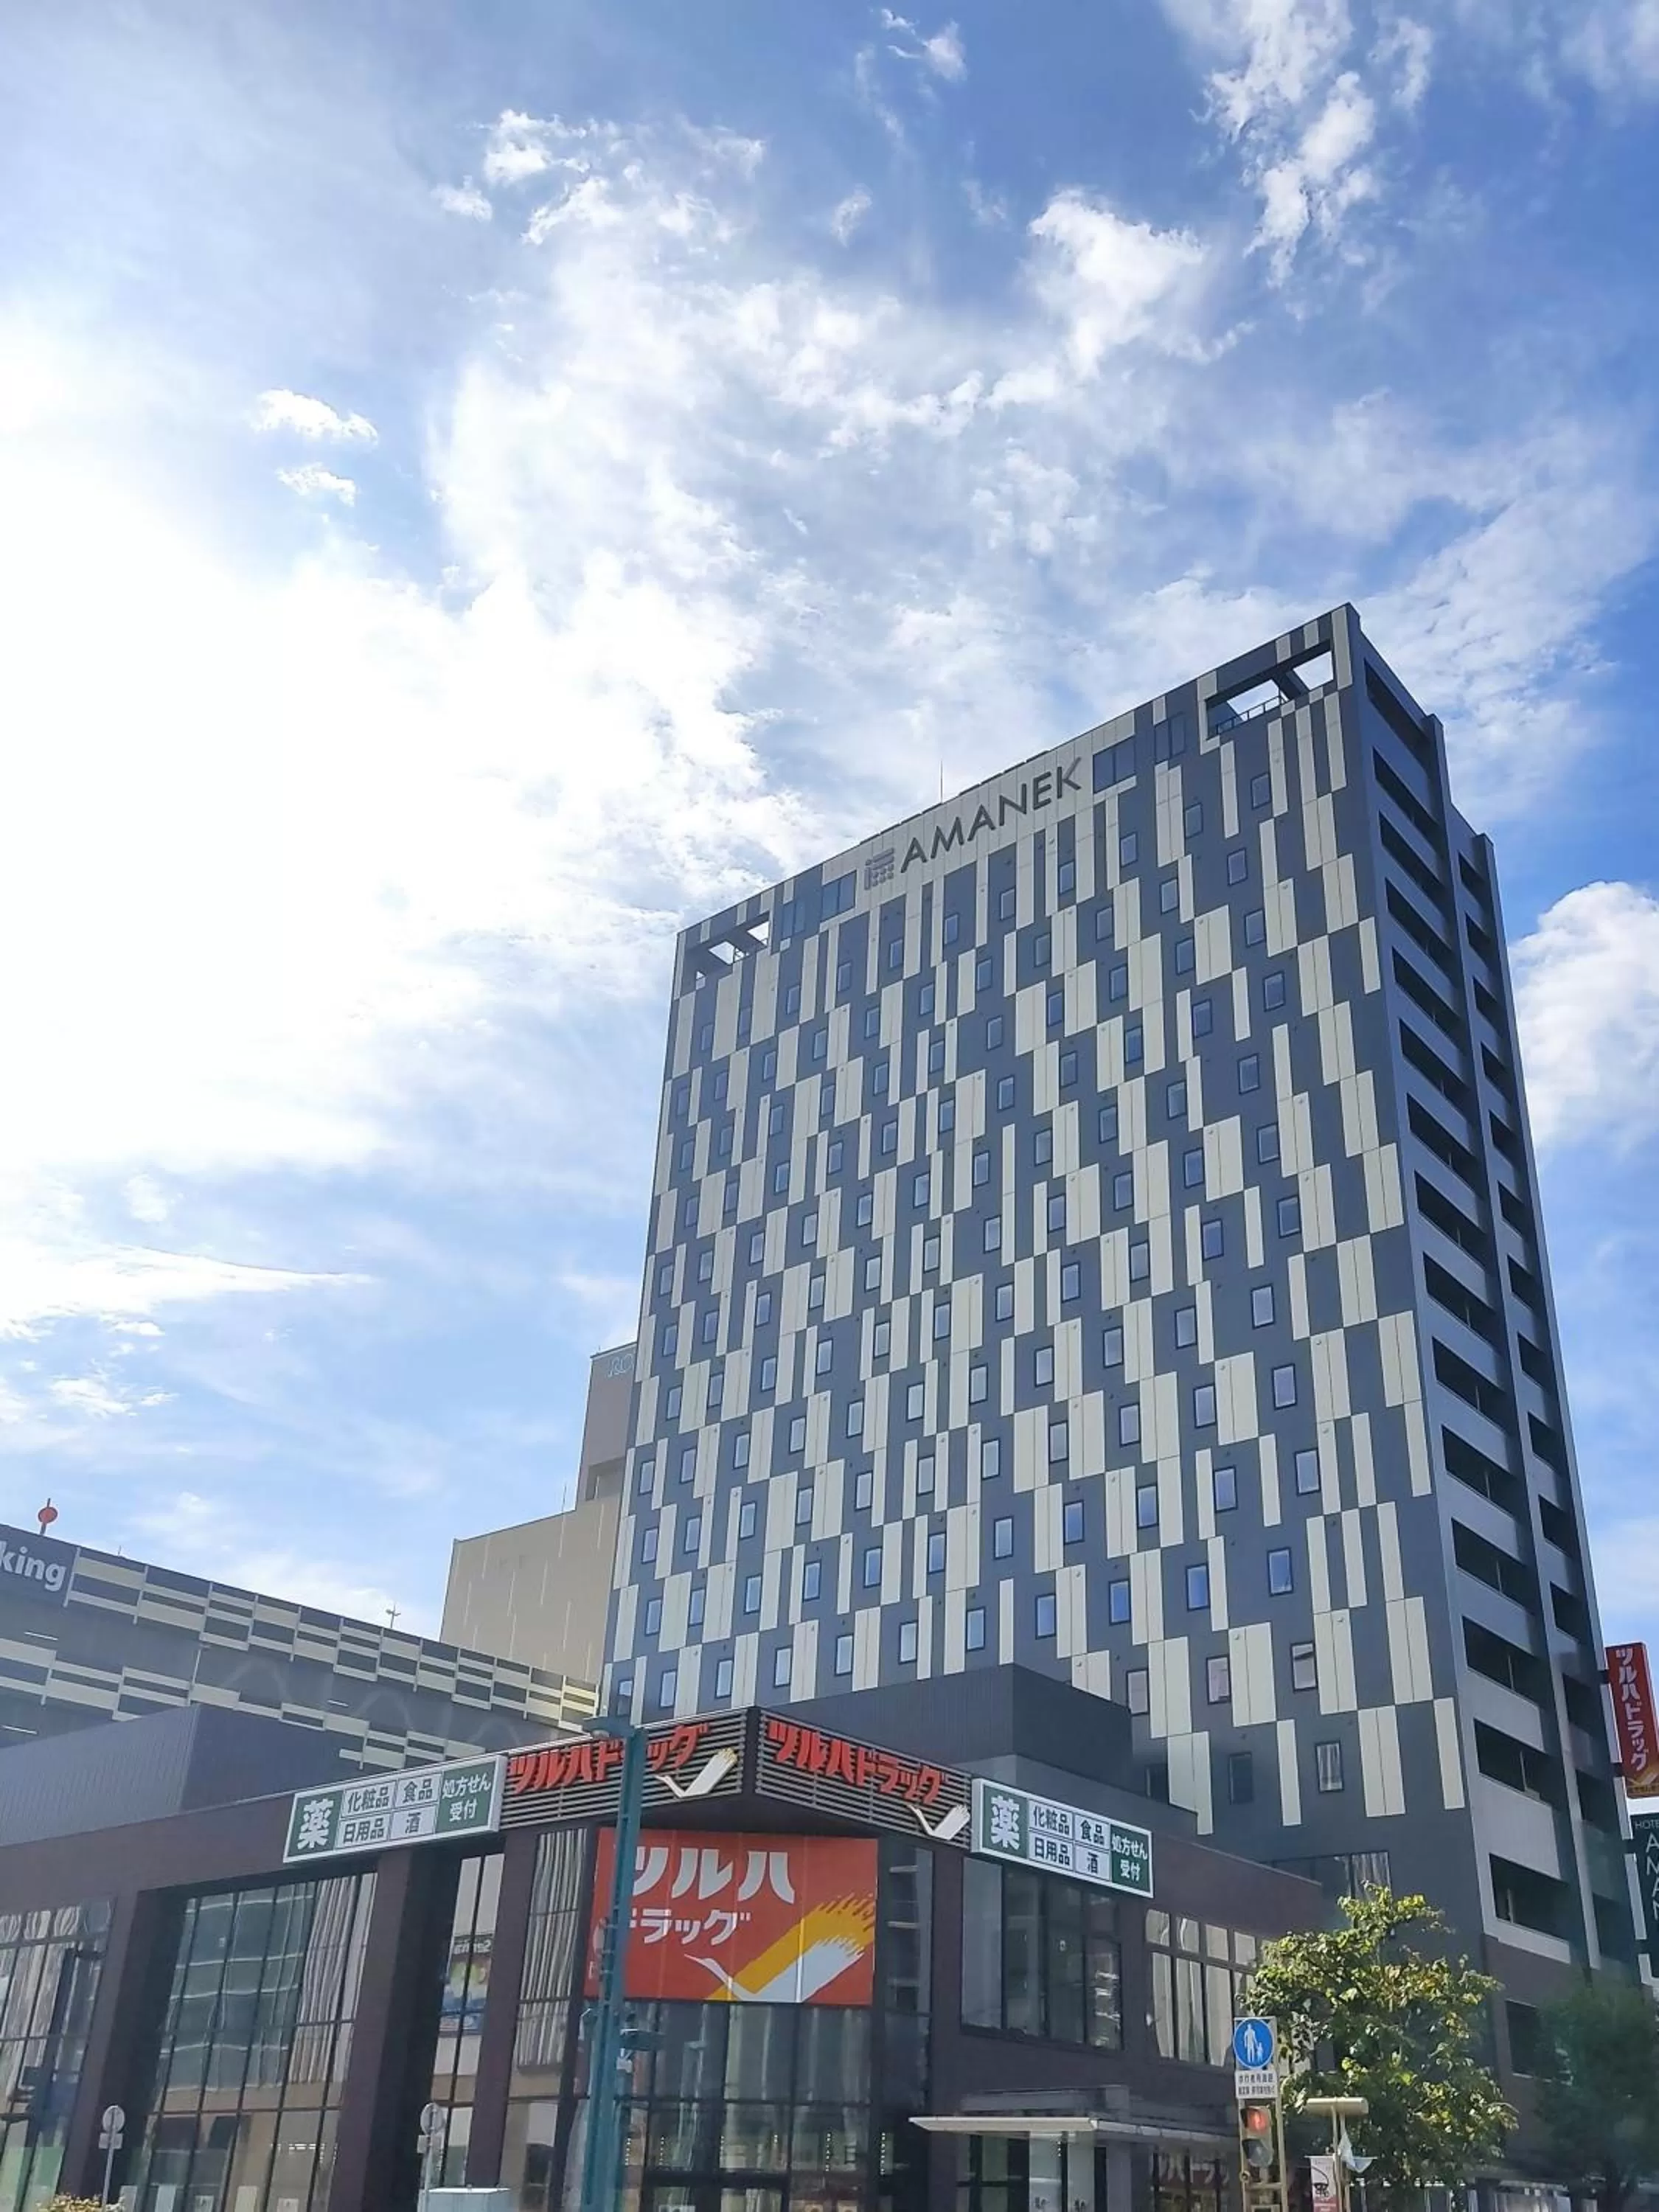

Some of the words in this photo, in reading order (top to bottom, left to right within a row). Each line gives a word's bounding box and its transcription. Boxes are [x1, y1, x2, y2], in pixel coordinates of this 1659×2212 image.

[900, 757, 1082, 874] AMANEK
[0, 1540, 66, 1592] king
[1615, 1646, 1649, 1771] ツルハドラッグ
[509, 1723, 711, 1795] ツルハドッグ
[768, 1719, 950, 1804] ツルハドラッグ
[347, 1786, 390, 1813] 化粧品
[403, 1778, 433, 1804] 食品
[442, 1771, 492, 1801] 処方せん
[297, 1798, 334, 1849] 薬
[405, 1812, 421, 1834] 酒
[449, 1801, 479, 1823] 受付
[990, 1795, 1020, 1851] 薬
[1033, 1806, 1070, 1836] 化粧品
[342, 1817, 385, 1843] 日用品
[1080, 1819, 1105, 1846] 食品
[1034, 1837, 1071, 1867] 日用品
[1111, 1832, 1148, 1861] 処方せん
[1087, 1851, 1099, 1875] 酒
[1120, 1859, 1141, 1882] 受付
